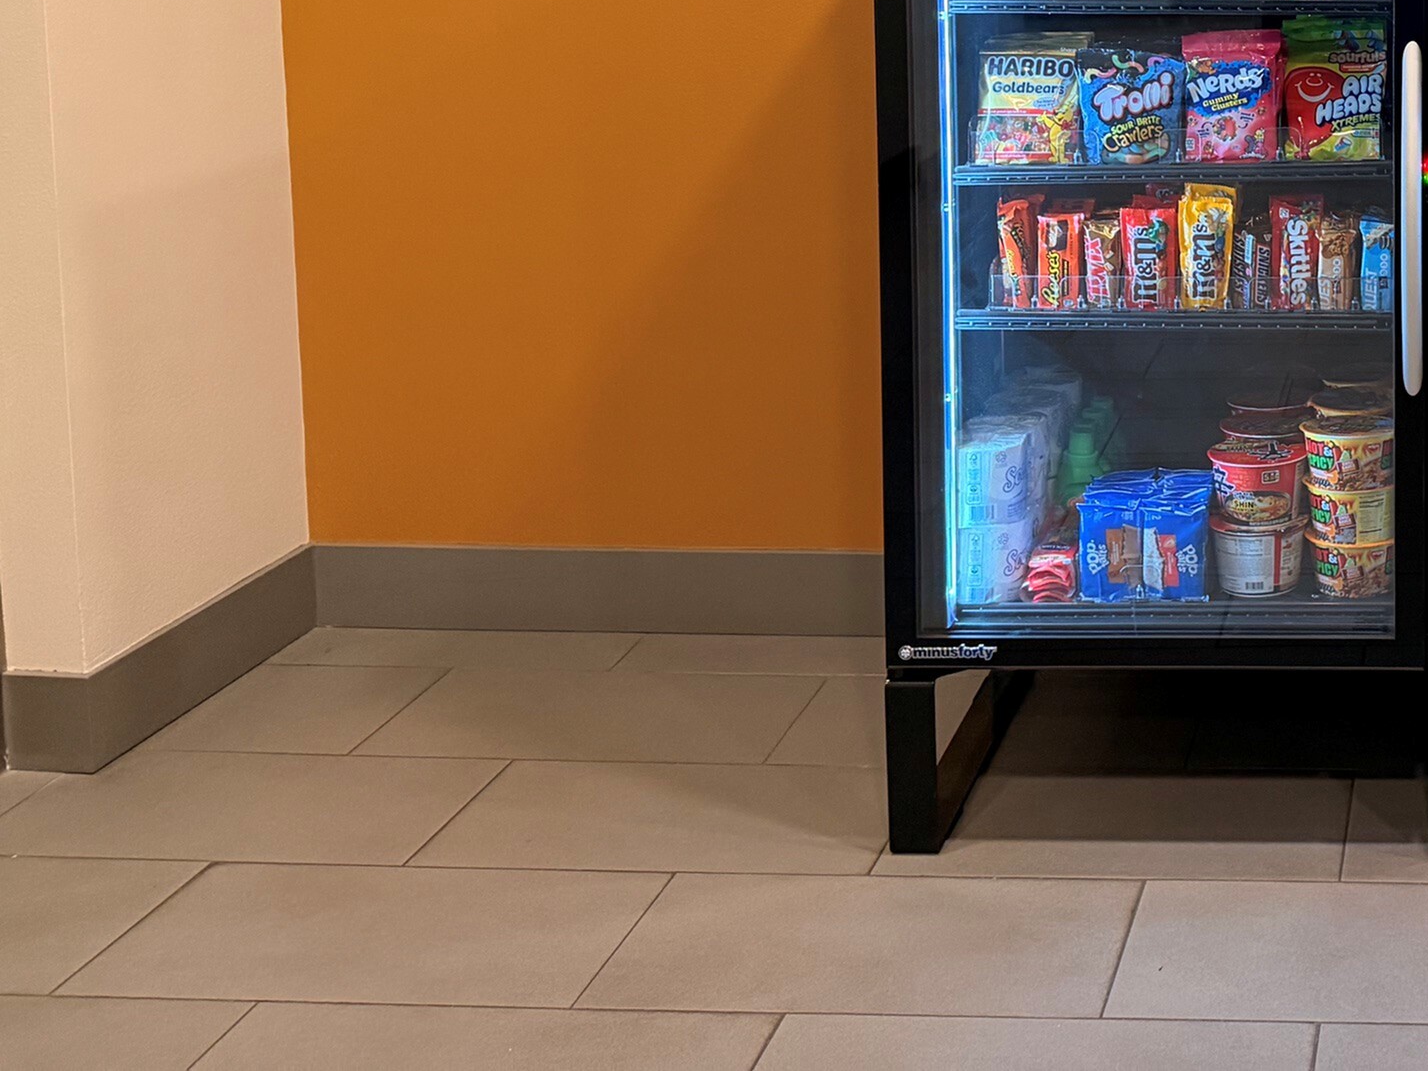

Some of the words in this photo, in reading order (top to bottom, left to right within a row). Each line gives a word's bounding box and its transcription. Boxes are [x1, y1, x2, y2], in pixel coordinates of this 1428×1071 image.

[988, 56, 1075, 78] HARIBO
[992, 81, 1065, 95] Goldbears
[1093, 72, 1172, 121] Trolli
[1342, 74, 1383, 97] AIR
[1202, 92, 1239, 107] Gummy
[1211, 97, 1248, 111] Clusters
[1315, 93, 1382, 125] HEADS
[1103, 125, 1163, 152] Crawlers
[1110, 121, 1134, 135] SOUR
[1287, 219, 1309, 306] Skittles
[1041, 250, 1060, 307] Reese's
[1257, 246, 1272, 304] SNICKERS
[1323, 446, 1334, 457] &
[912, 643, 998, 661] minusforty
